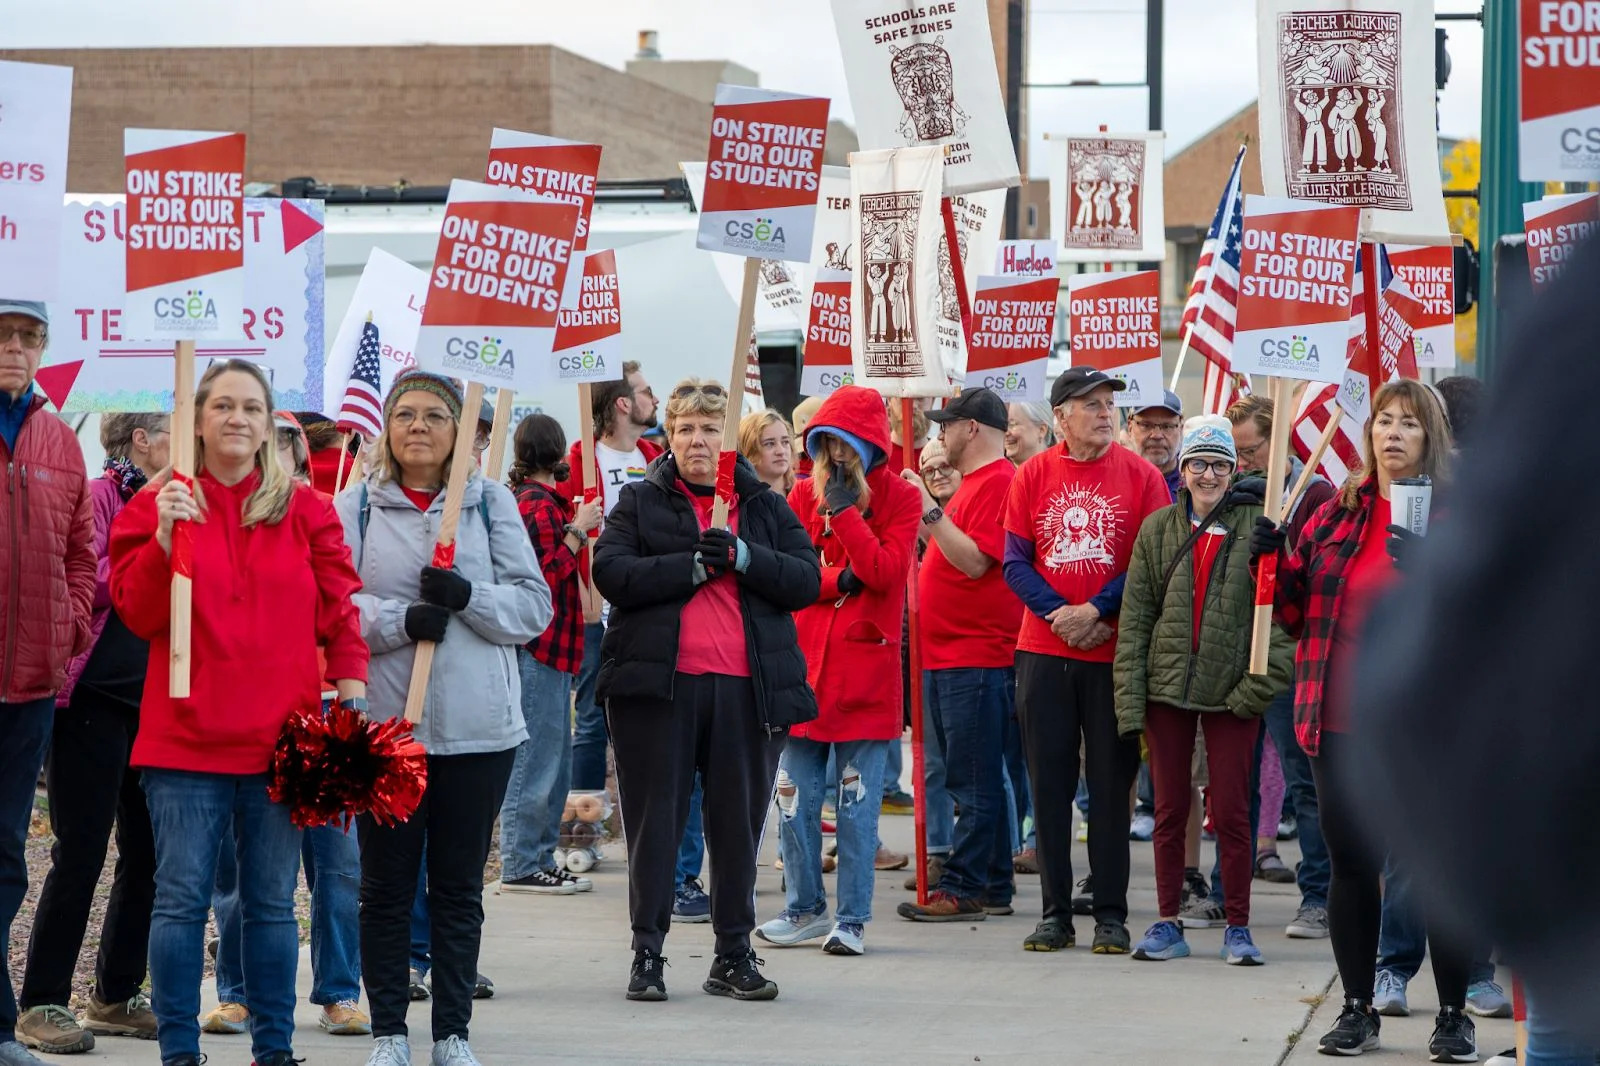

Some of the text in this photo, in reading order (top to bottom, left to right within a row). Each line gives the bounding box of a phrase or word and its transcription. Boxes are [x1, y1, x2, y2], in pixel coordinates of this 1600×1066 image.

[865, 2, 956, 30] SCHOOLS ARE
[1282, 14, 1397, 31] TEACHER WORKING
[873, 19, 953, 44] SAFE ZONES
[1316, 31, 1364, 39] CONDITIONS
[713, 117, 825, 149] ON STRIKE
[722, 140, 814, 169] FOR OUR
[127, 169, 243, 197] ON STRIKE
[488, 160, 518, 183] ON
[521, 165, 595, 195] STRIKE
[709, 160, 818, 191] STUDENTS
[1336, 174, 1366, 182] EQUAL
[1291, 183, 1407, 198] STUDENT LEARNING
[1328, 196, 1377, 204] CONDITIONS
[140, 197, 235, 224] FOR OUR
[863, 196, 897, 211] TEACHER
[129, 224, 242, 252] STUDENTS
[443, 216, 479, 243] ON
[481, 223, 571, 264] STRIKE
[1244, 230, 1354, 261] ON STRIKE
[1528, 227, 1553, 247] ON
[450, 243, 557, 286] FOR OUR
[1255, 253, 1345, 284] FOR OUR
[1397, 265, 1452, 282] STRIKE
[434, 266, 559, 312] STUDENTS
[582, 273, 617, 292] RIKE
[1242, 276, 1350, 307] STUDENTS
[1414, 281, 1446, 298] OUR
[582, 291, 614, 309] OUR
[813, 292, 836, 311] ON
[974, 300, 1055, 317] ON STRIKE
[1072, 297, 1158, 315] ON STRIKE
[819, 310, 850, 330] FOR
[981, 316, 1047, 333] FOR OUR
[1081, 314, 1153, 332] FOR OUR
[1384, 306, 1413, 344] STRIKE
[972, 332, 1050, 349] STUDENTS
[1073, 332, 1159, 350] STUDENTS
[1384, 330, 1403, 357] OUR
[866, 353, 900, 365] STUDENT
[608, 468, 624, 485] I
[1044, 506, 1056, 531] FEAST
[1055, 495, 1066, 507] OF
[1068, 490, 1091, 500] SAINT
[1092, 494, 1115, 521] ARNOLD
